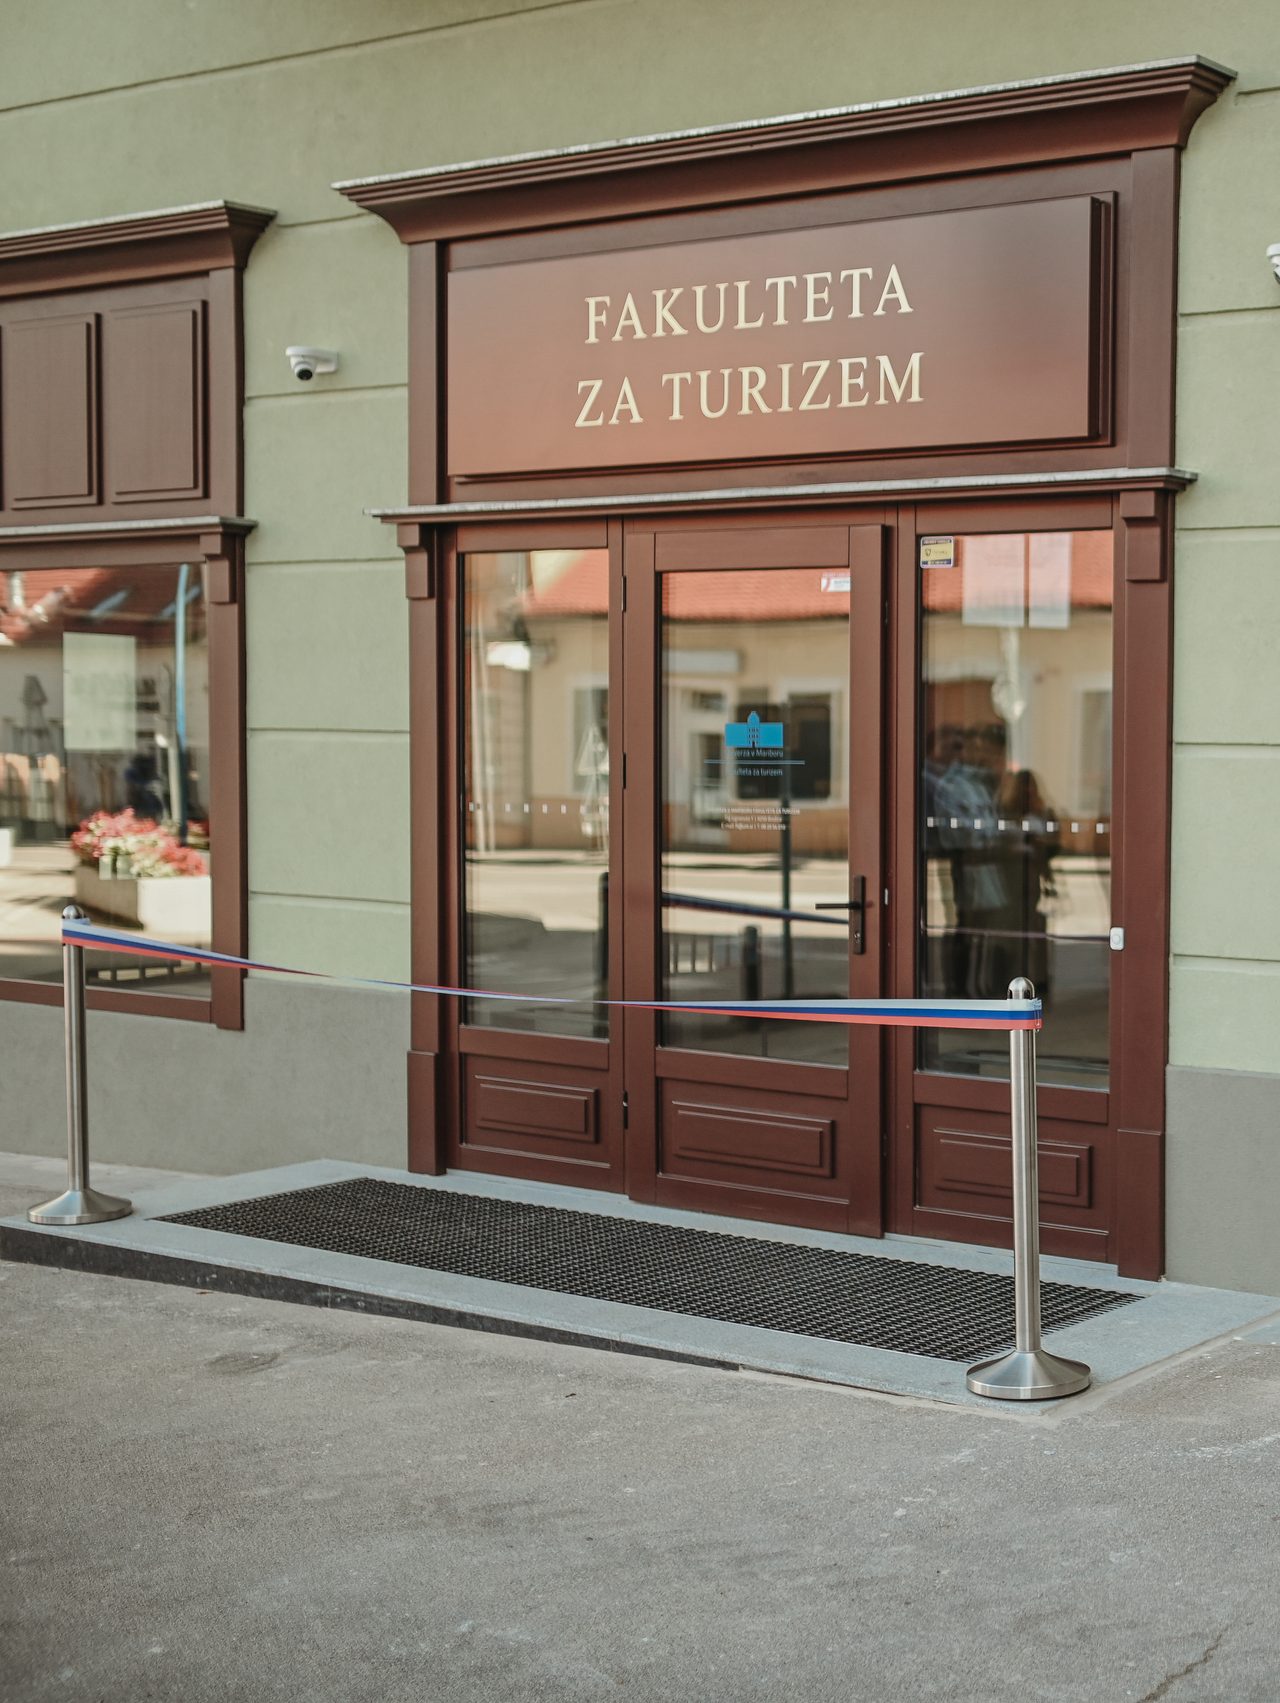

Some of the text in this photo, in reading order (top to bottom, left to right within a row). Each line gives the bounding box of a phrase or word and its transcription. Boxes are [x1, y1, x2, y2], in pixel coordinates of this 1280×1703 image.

[584, 263, 914, 344] FAKULTETA
[574, 351, 925, 428] ZA TURIZEM
